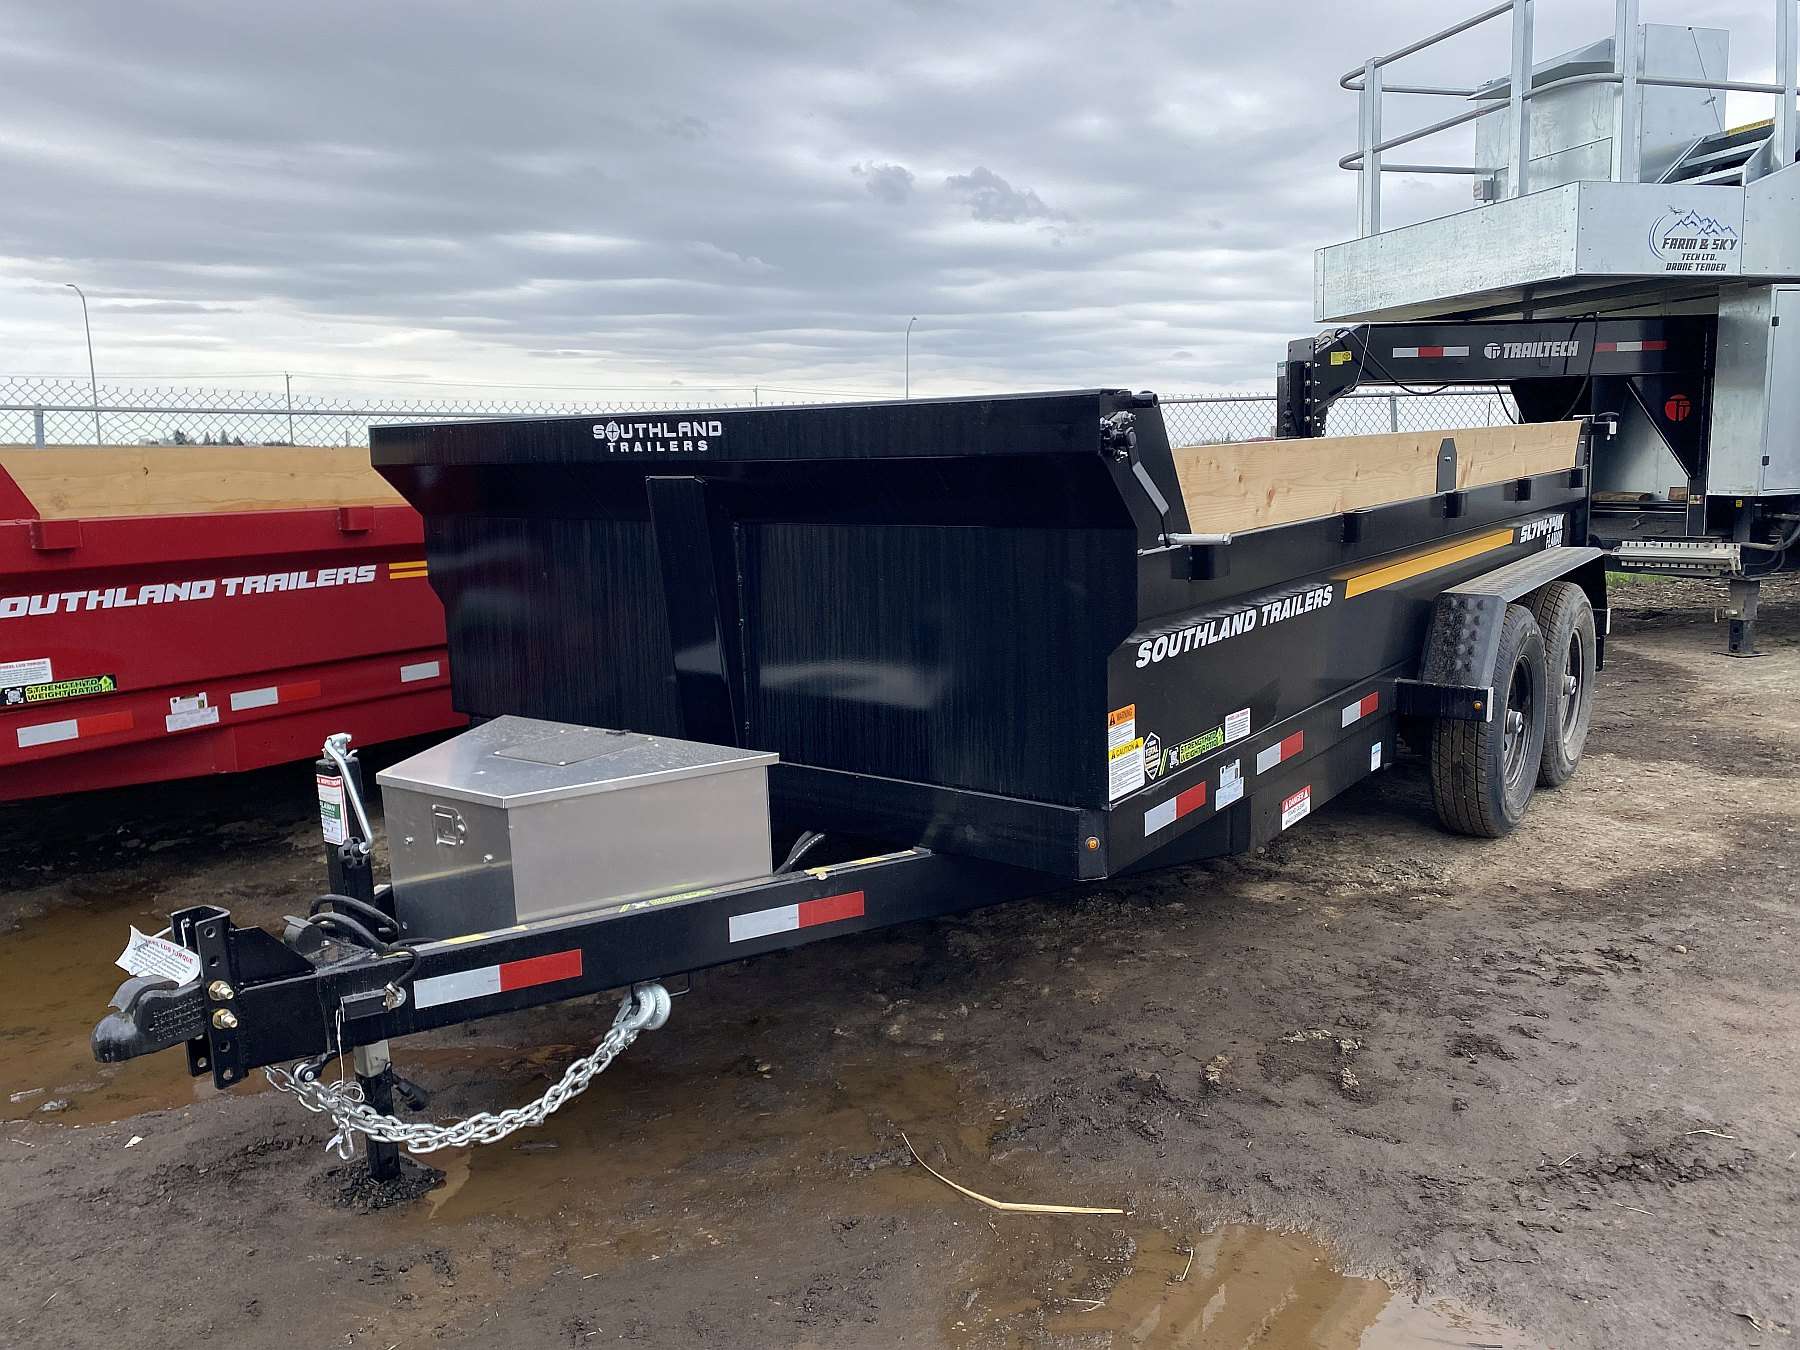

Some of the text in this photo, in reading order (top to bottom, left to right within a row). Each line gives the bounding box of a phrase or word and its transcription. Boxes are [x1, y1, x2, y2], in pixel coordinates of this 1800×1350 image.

[1662, 237, 1738, 250] FARM & SKY
[1681, 252, 1717, 261] TECH LTD.
[1665, 262, 1727, 272] DRONE TENDER
[1503, 341, 1579, 359] TRAILTECH
[592, 420, 722, 441] SOUTHLAND
[607, 440, 708, 453] TRAILERS
[221, 564, 377, 597] TRAILERS
[1135, 585, 1333, 669] SOUTHLAND TRAILERS
[26, 683, 83, 695] STRENGTH
[27, 685, 101, 701] WEIGHT RATIO
[1180, 734, 1209, 753] STRENGTH
